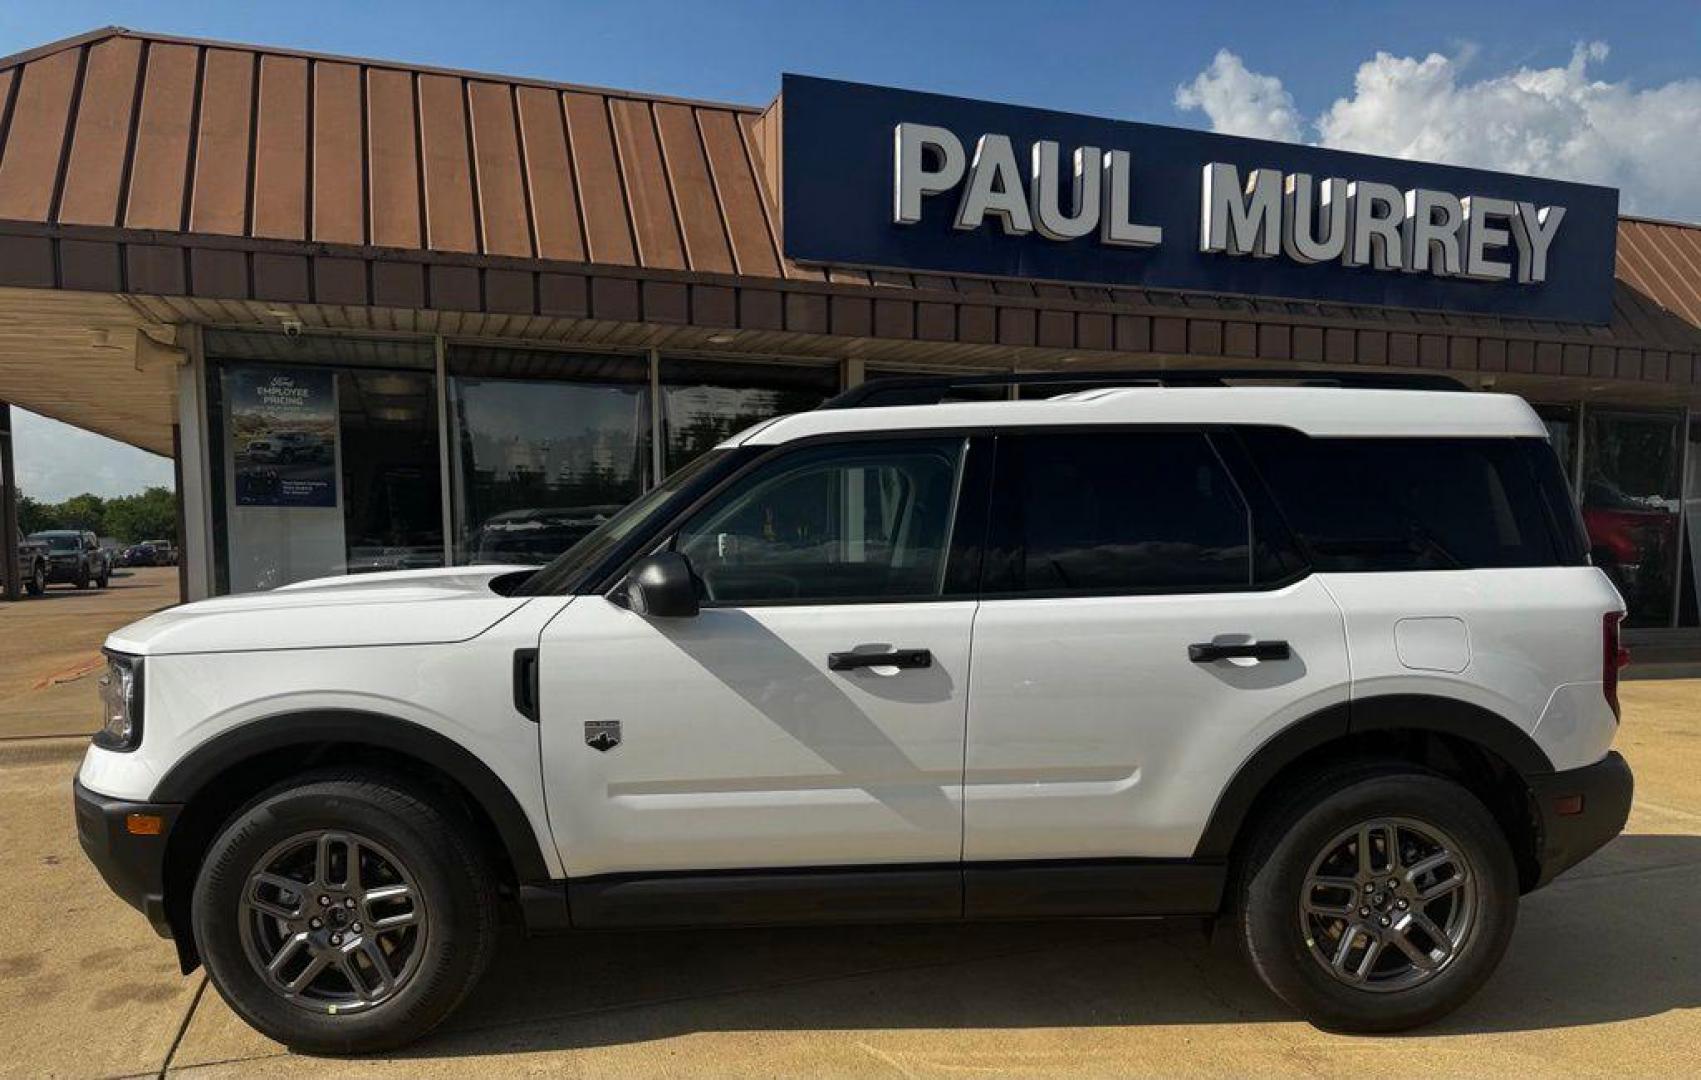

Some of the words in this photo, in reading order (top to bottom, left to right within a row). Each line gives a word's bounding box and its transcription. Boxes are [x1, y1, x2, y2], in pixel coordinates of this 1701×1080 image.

[893, 122, 1162, 247] PAUL
[1200, 162, 1566, 284] MURREY
[256, 386, 309, 398] EMPLOYEE
[264, 396, 304, 406] PRICING
